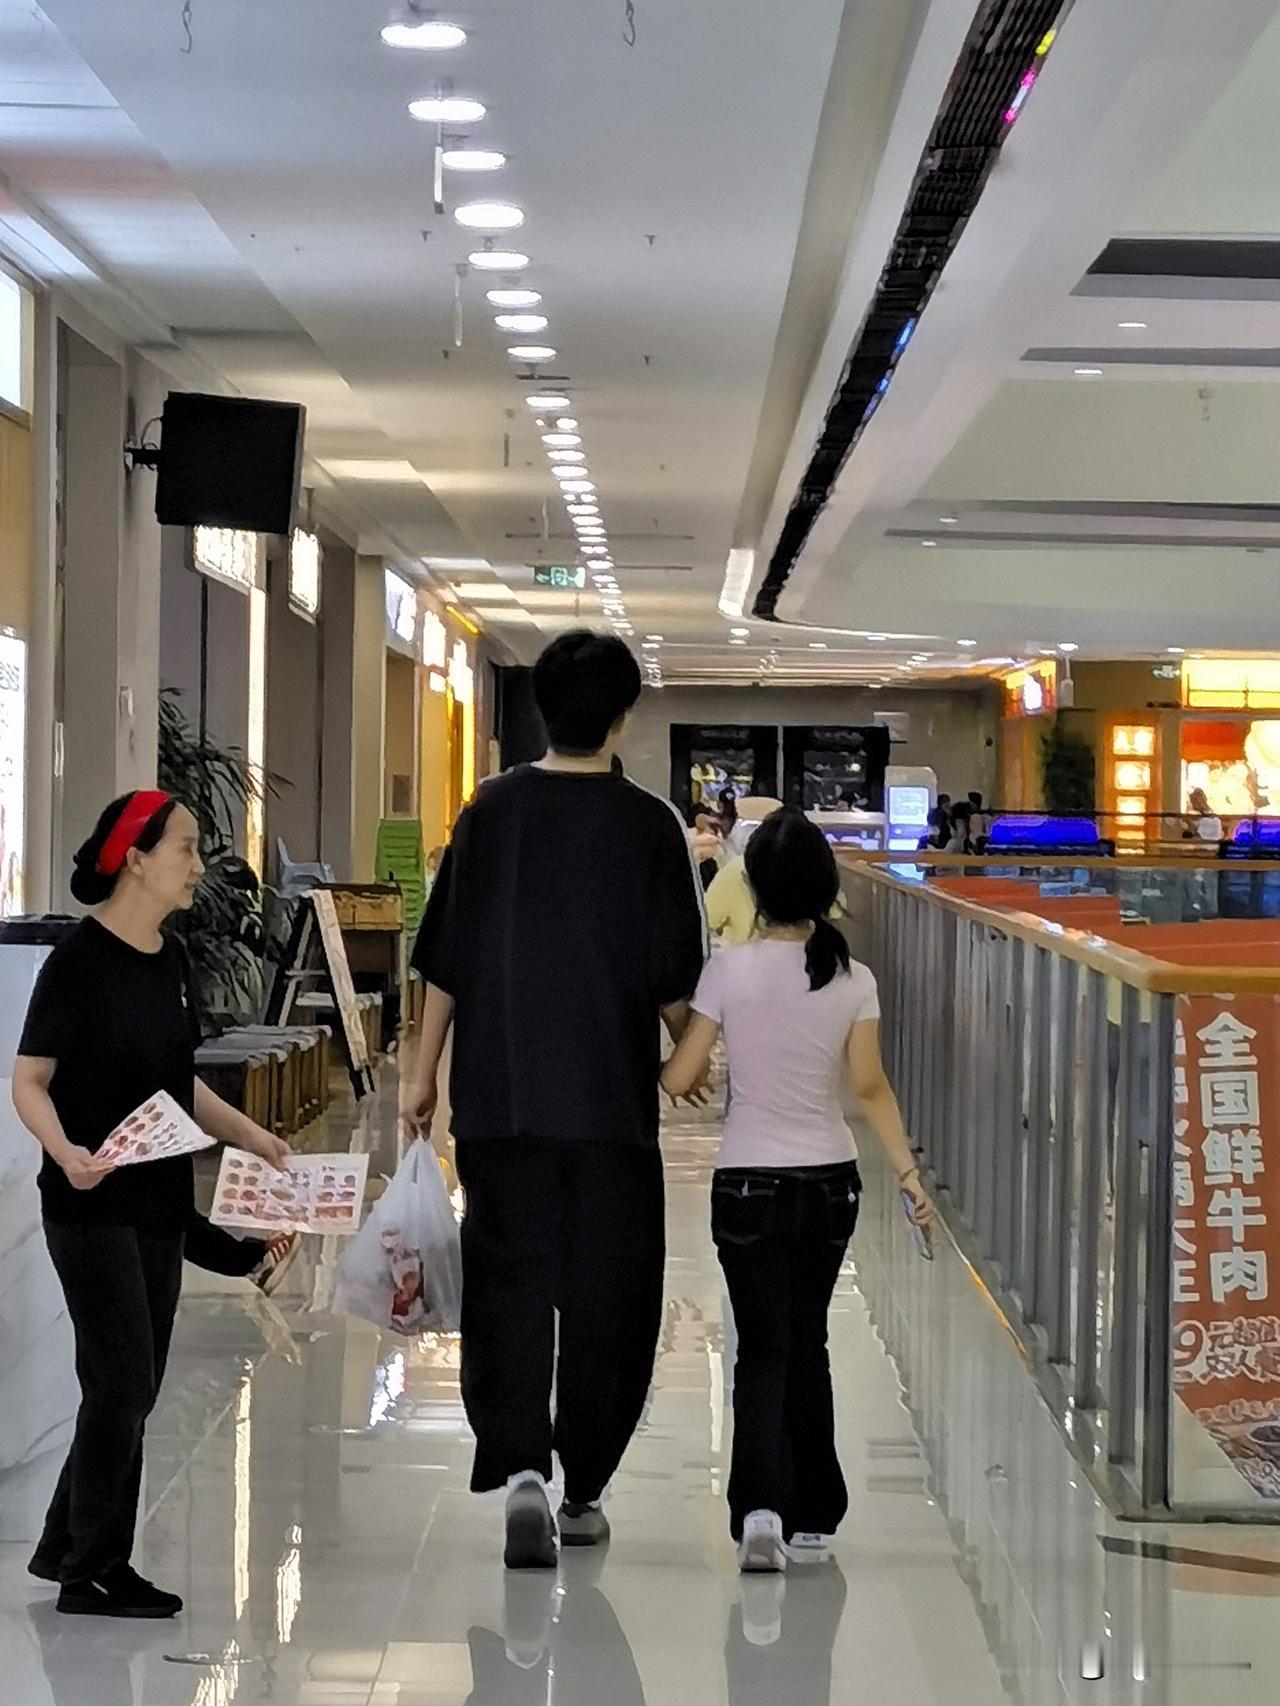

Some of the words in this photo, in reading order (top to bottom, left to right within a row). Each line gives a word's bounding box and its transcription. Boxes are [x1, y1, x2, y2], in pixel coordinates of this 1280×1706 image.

[1196, 1011, 1267, 1303] 全国鲜牛肉
